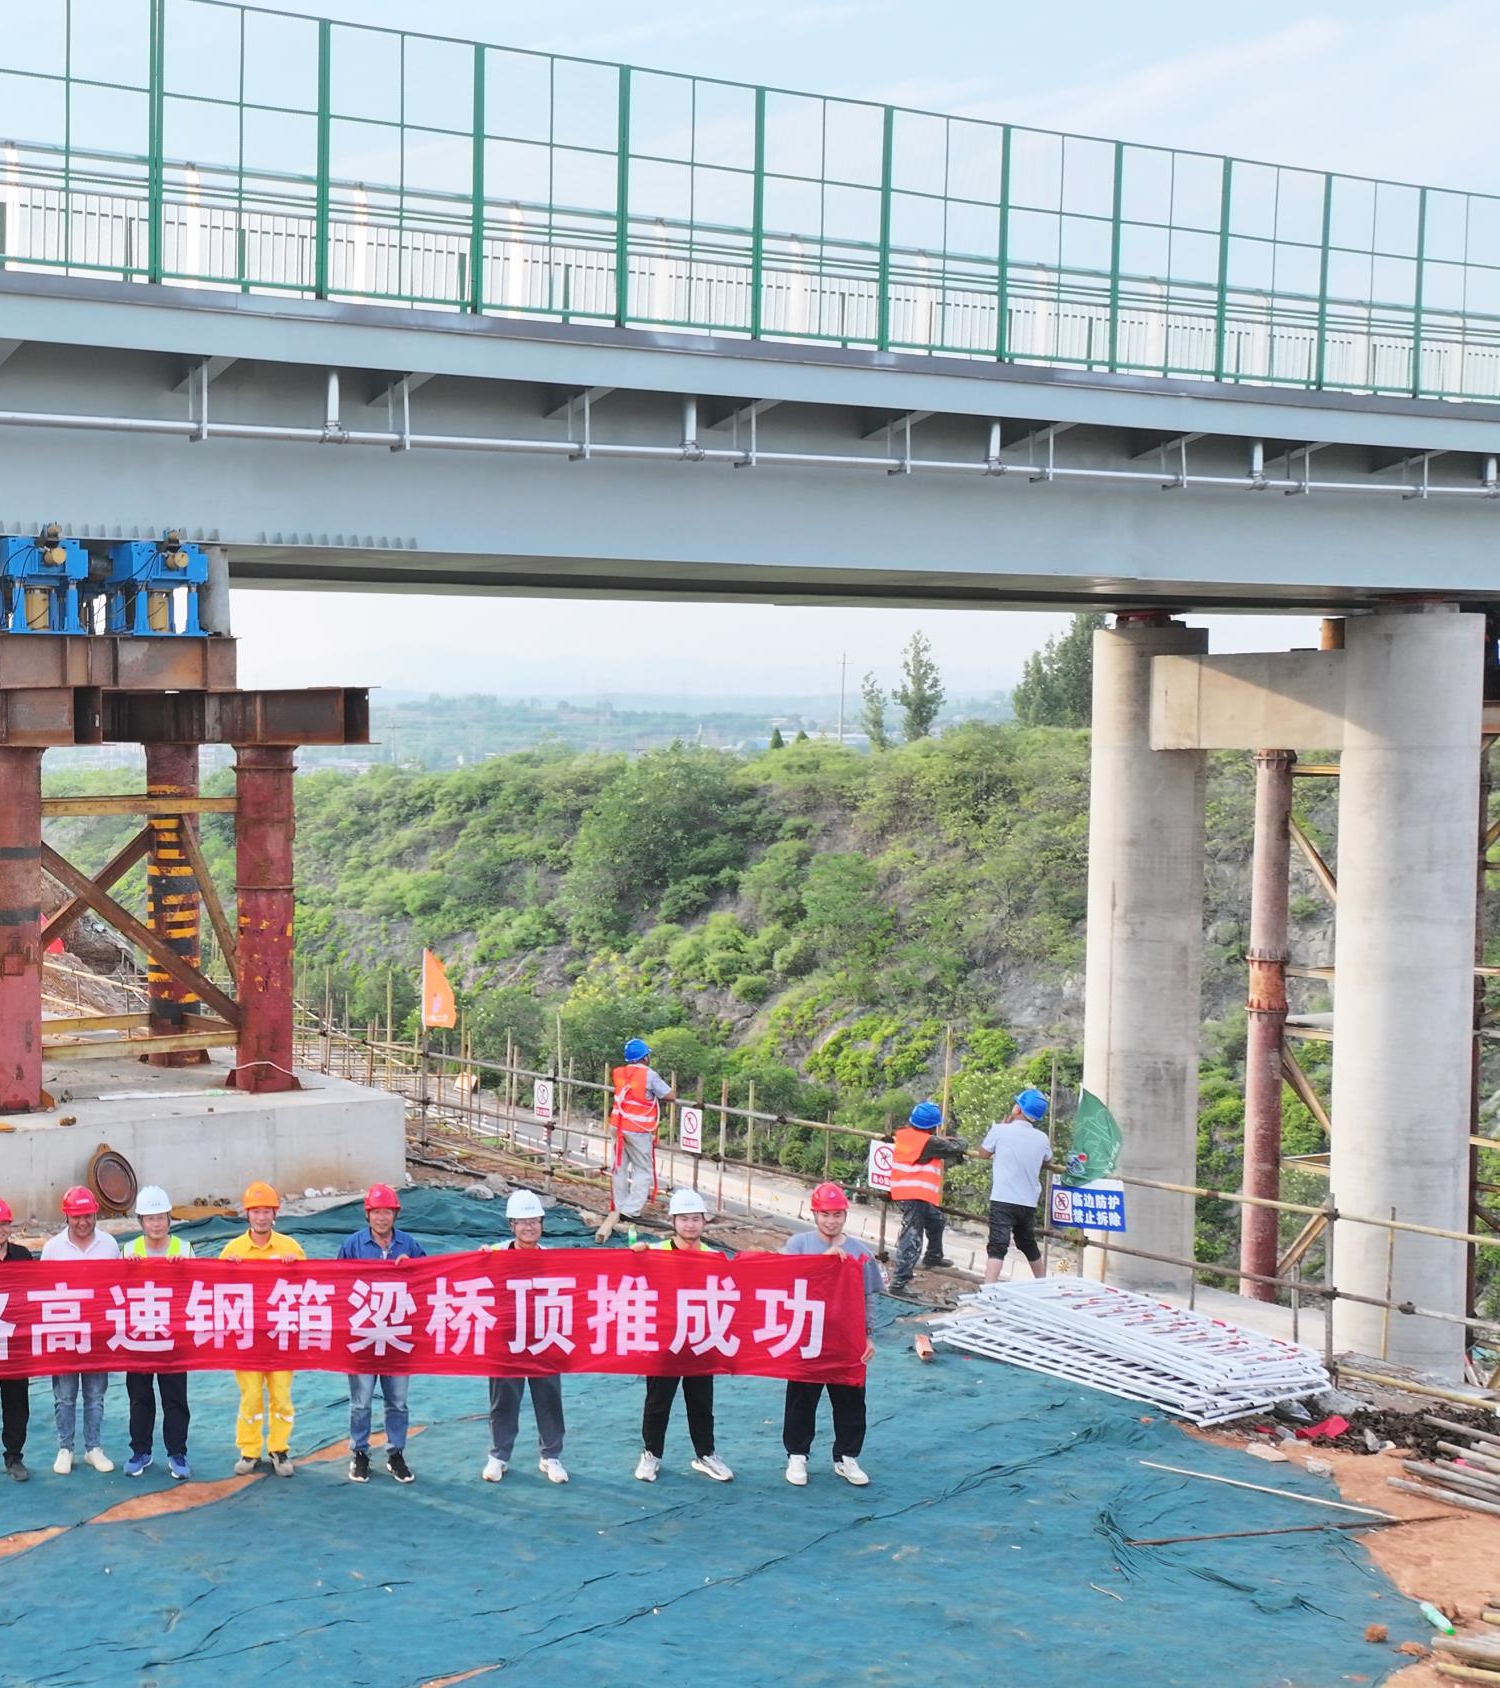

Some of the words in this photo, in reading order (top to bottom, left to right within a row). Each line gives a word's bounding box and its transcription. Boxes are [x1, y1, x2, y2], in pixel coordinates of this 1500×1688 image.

[1073, 1192, 1120, 1210] 临边防护
[1073, 1209, 1121, 1226] 禁止拆除
